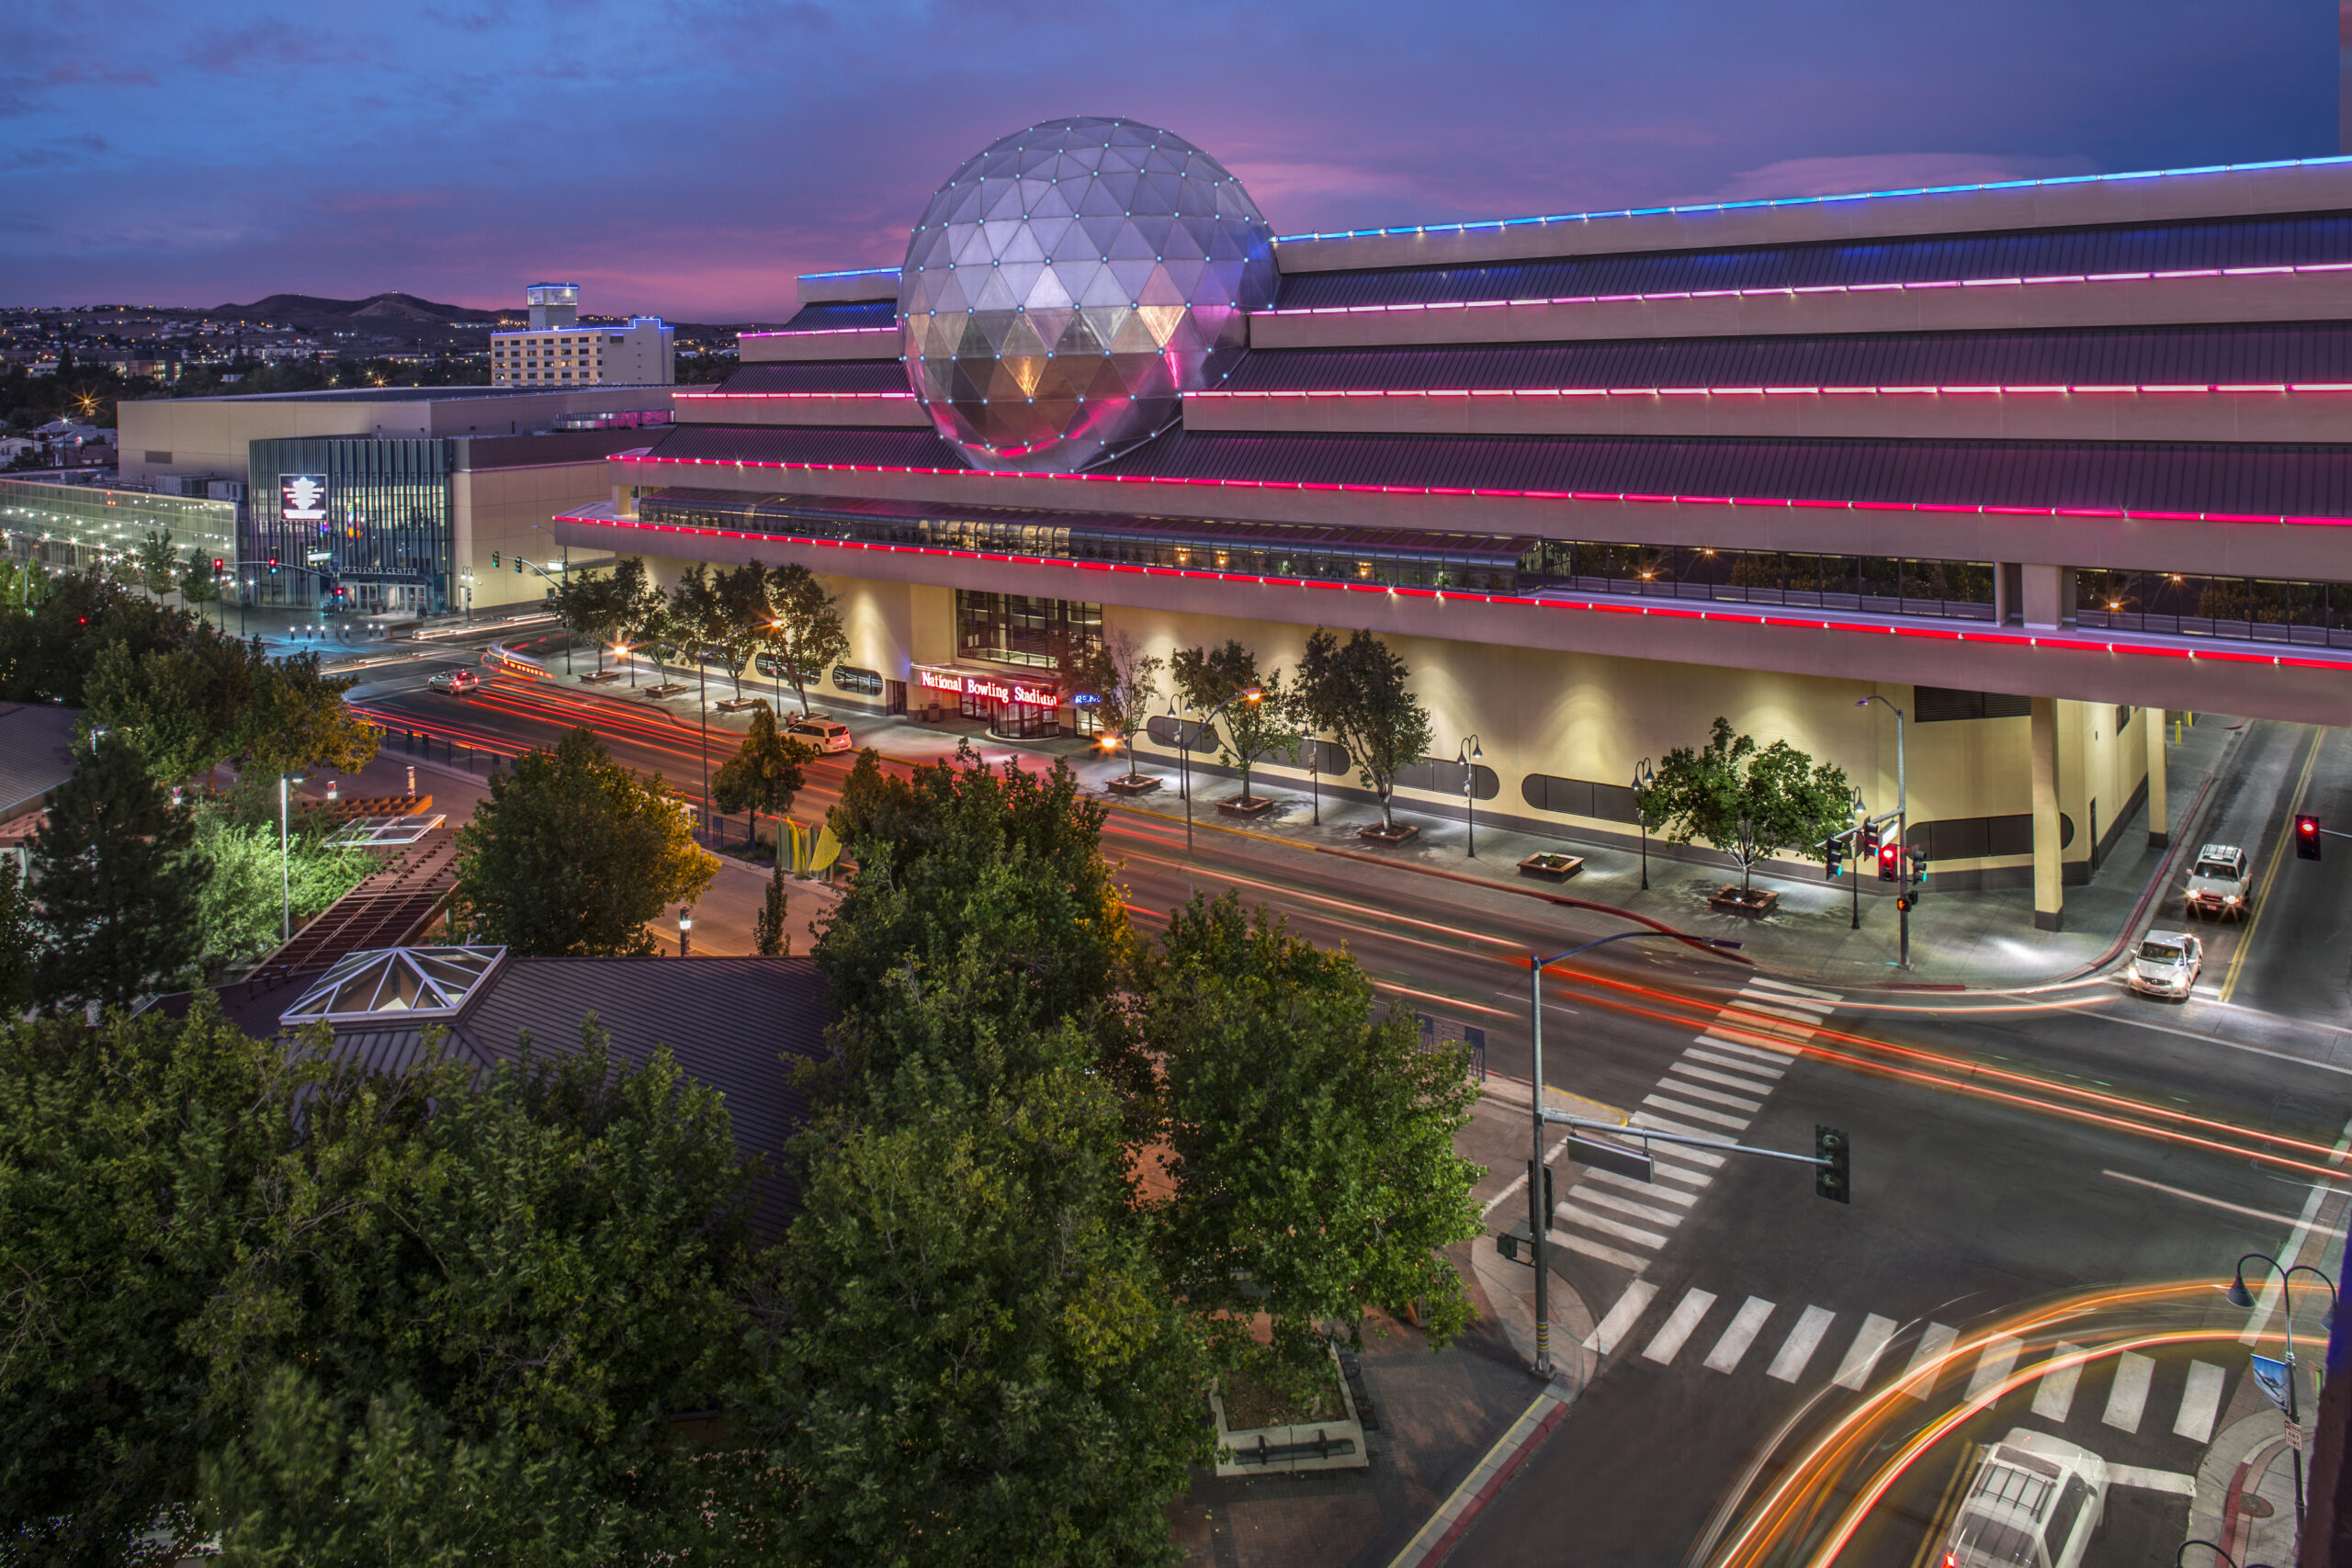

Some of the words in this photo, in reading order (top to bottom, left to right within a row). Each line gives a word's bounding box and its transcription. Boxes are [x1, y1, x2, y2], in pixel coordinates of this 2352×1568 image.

[353, 566, 383, 574] EVENTS
[386, 567, 418, 576] CENTER
[922, 671, 963, 692] National
[967, 679, 1009, 704] Bowling
[1014, 686, 1057, 706] Stadium
